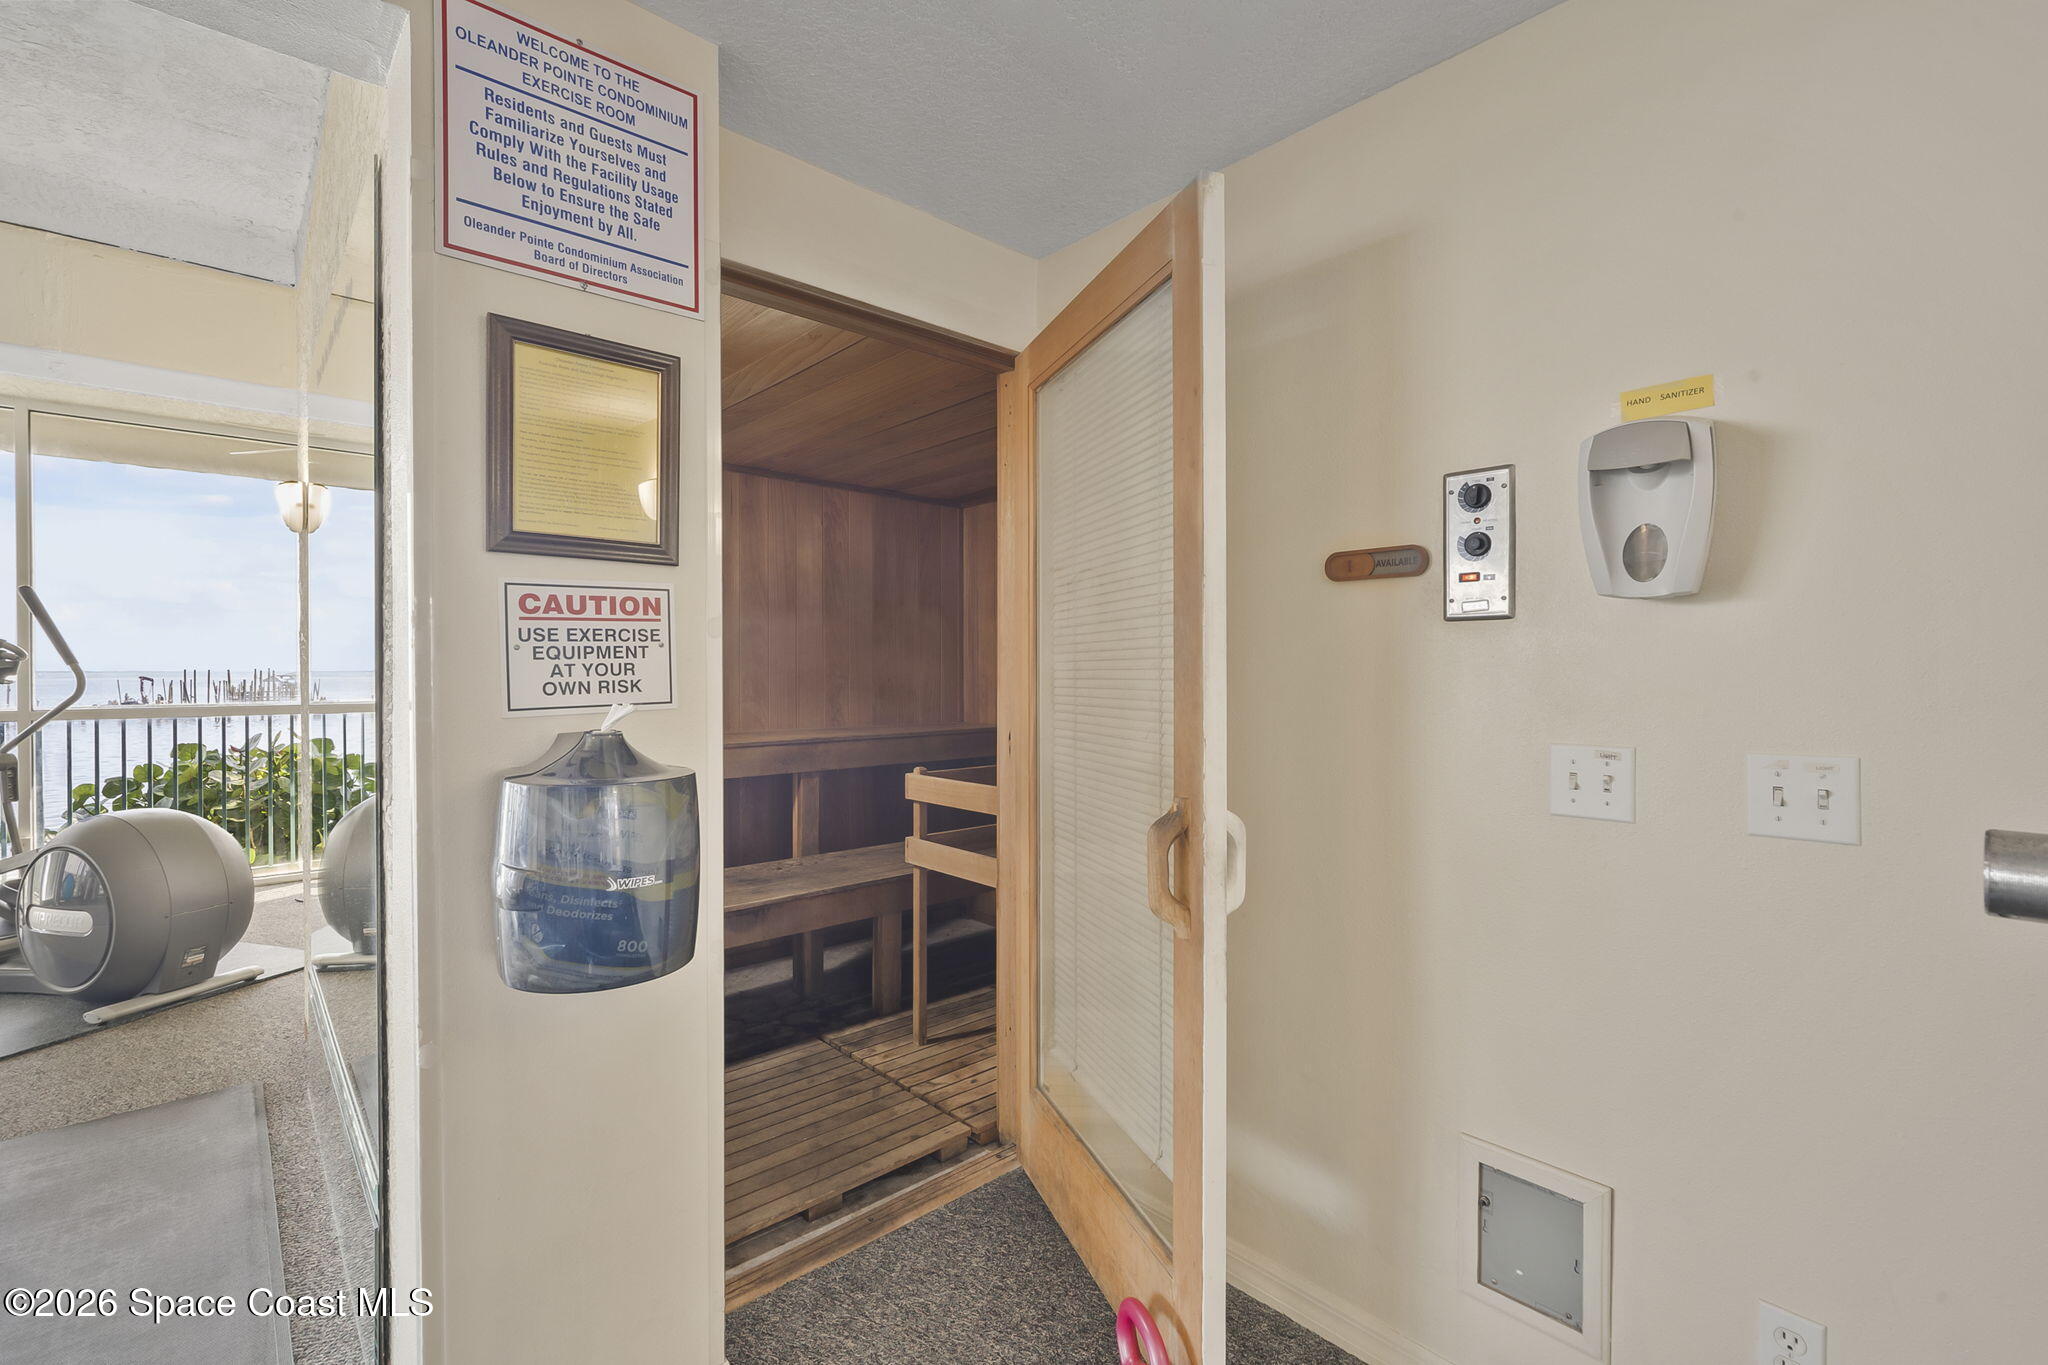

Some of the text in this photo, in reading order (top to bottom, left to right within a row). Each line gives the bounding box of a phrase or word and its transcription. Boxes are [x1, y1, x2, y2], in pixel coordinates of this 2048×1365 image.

[455, 26, 688, 130] OLEANDER POINTE CONDOMINIUM
[516, 31, 640, 93] WELCOME TO THE
[522, 72, 636, 126] EXERCISE ROOM
[484, 87, 667, 166] Residents and Guests Must
[485, 107, 666, 182] Familiarize Yourselves and
[469, 120, 679, 204] Comply With the Facility Usage
[476, 142, 673, 219] Rules and Regulations Stated
[493, 167, 661, 231] Below to Ensure the Safe
[522, 195, 637, 242] Enjoyment by All.
[464, 215, 684, 287] Oleander Pointe Condominium Association
[534, 251, 628, 285] Board of Directors
[1626, 387, 1705, 406] HAND SANITIZER
[518, 593, 661, 616] CAUTION
[518, 627, 661, 643] USE EXERCISE
[532, 645, 649, 660] EQUIPMENT
[542, 679, 642, 696] OWN RISK
[550, 662, 636, 678] AT YOUR
[616, 874, 656, 890] WIPES
[617, 939, 648, 953] 800
